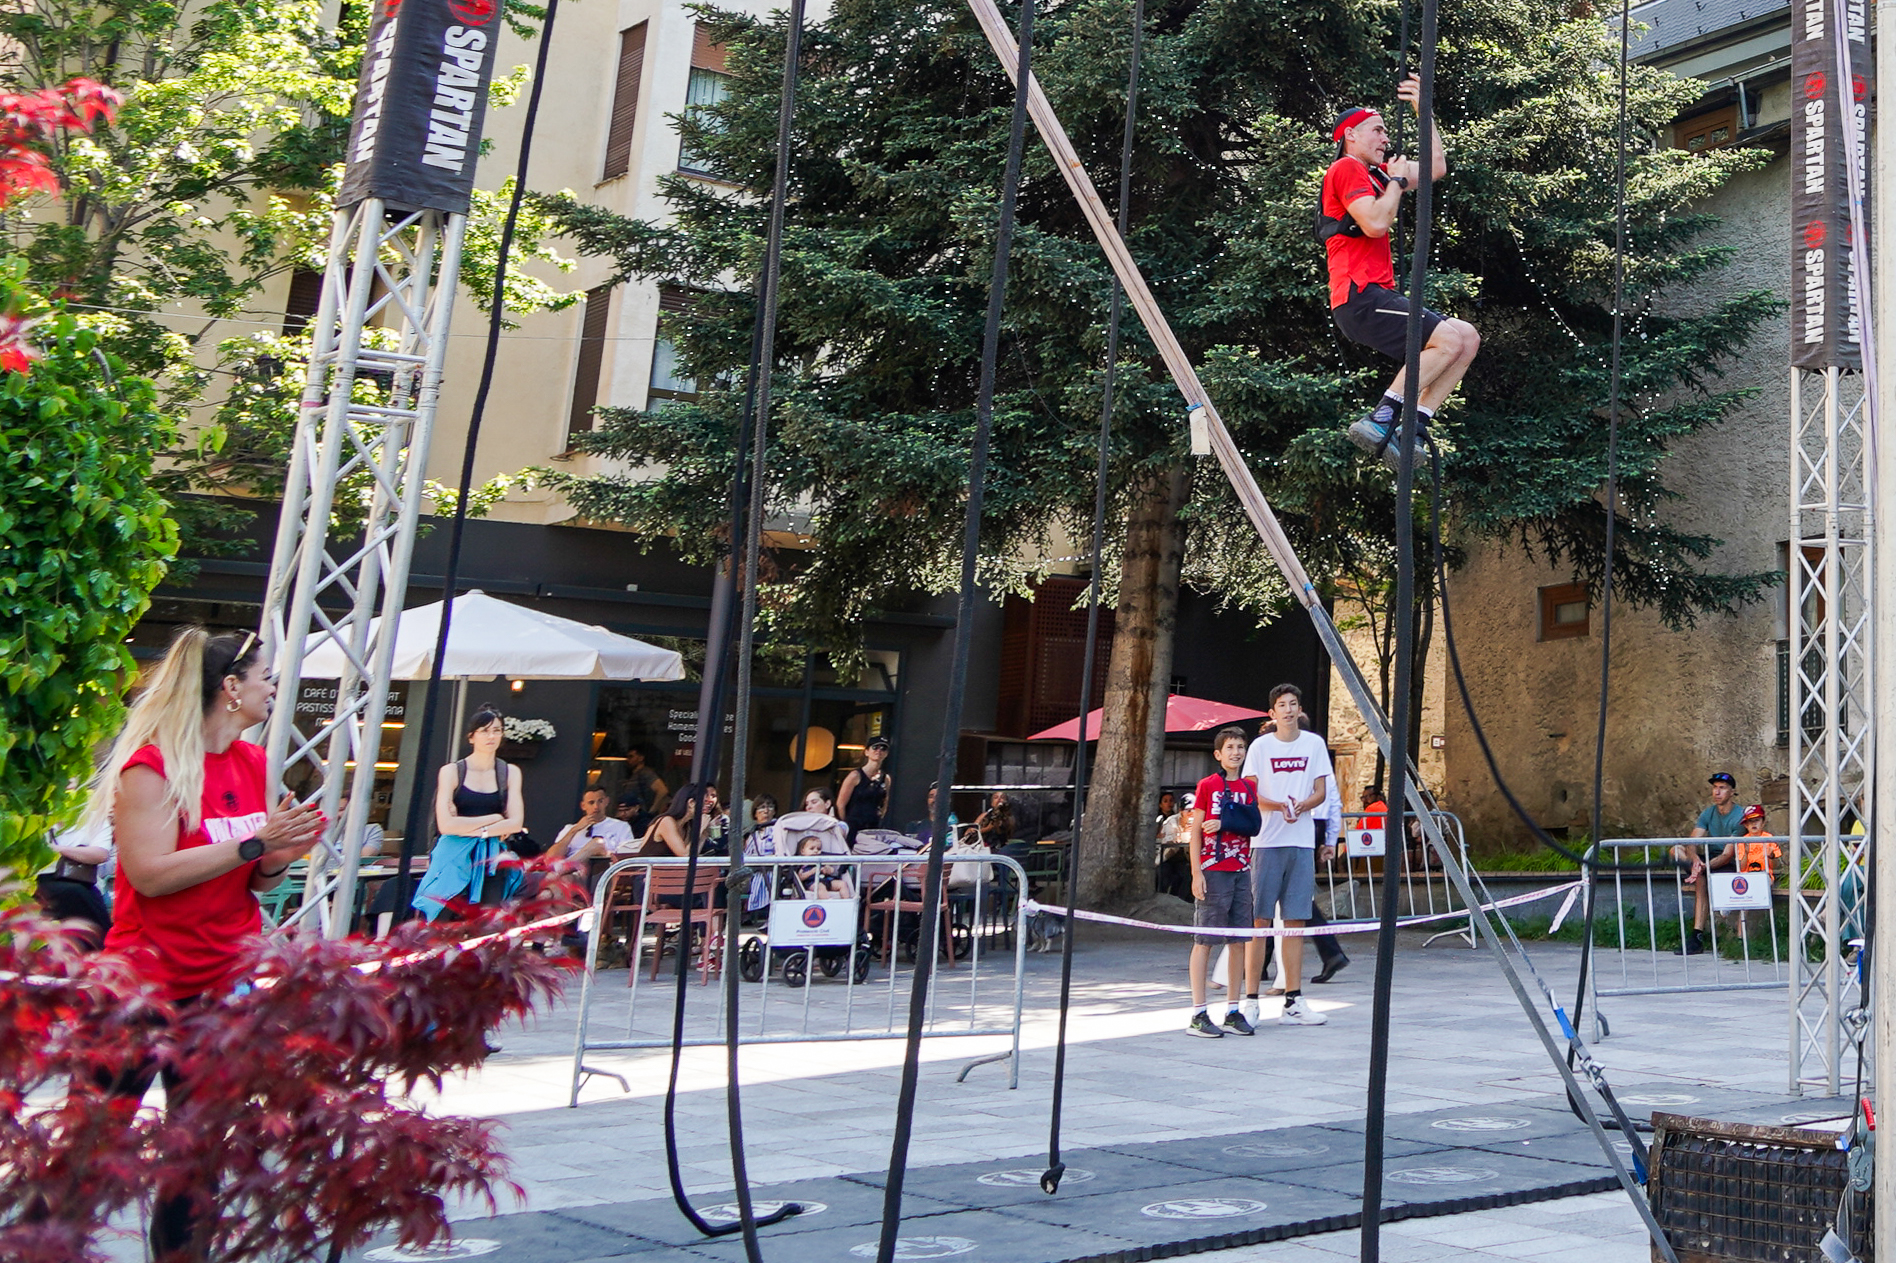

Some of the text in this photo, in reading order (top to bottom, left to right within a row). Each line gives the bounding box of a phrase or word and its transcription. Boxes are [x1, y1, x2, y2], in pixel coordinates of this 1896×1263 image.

[422, 25, 488, 172] SPARTAN
[1804, 99, 1825, 195] SPARTAN
[1804, 248, 1825, 345] SPARTAN
